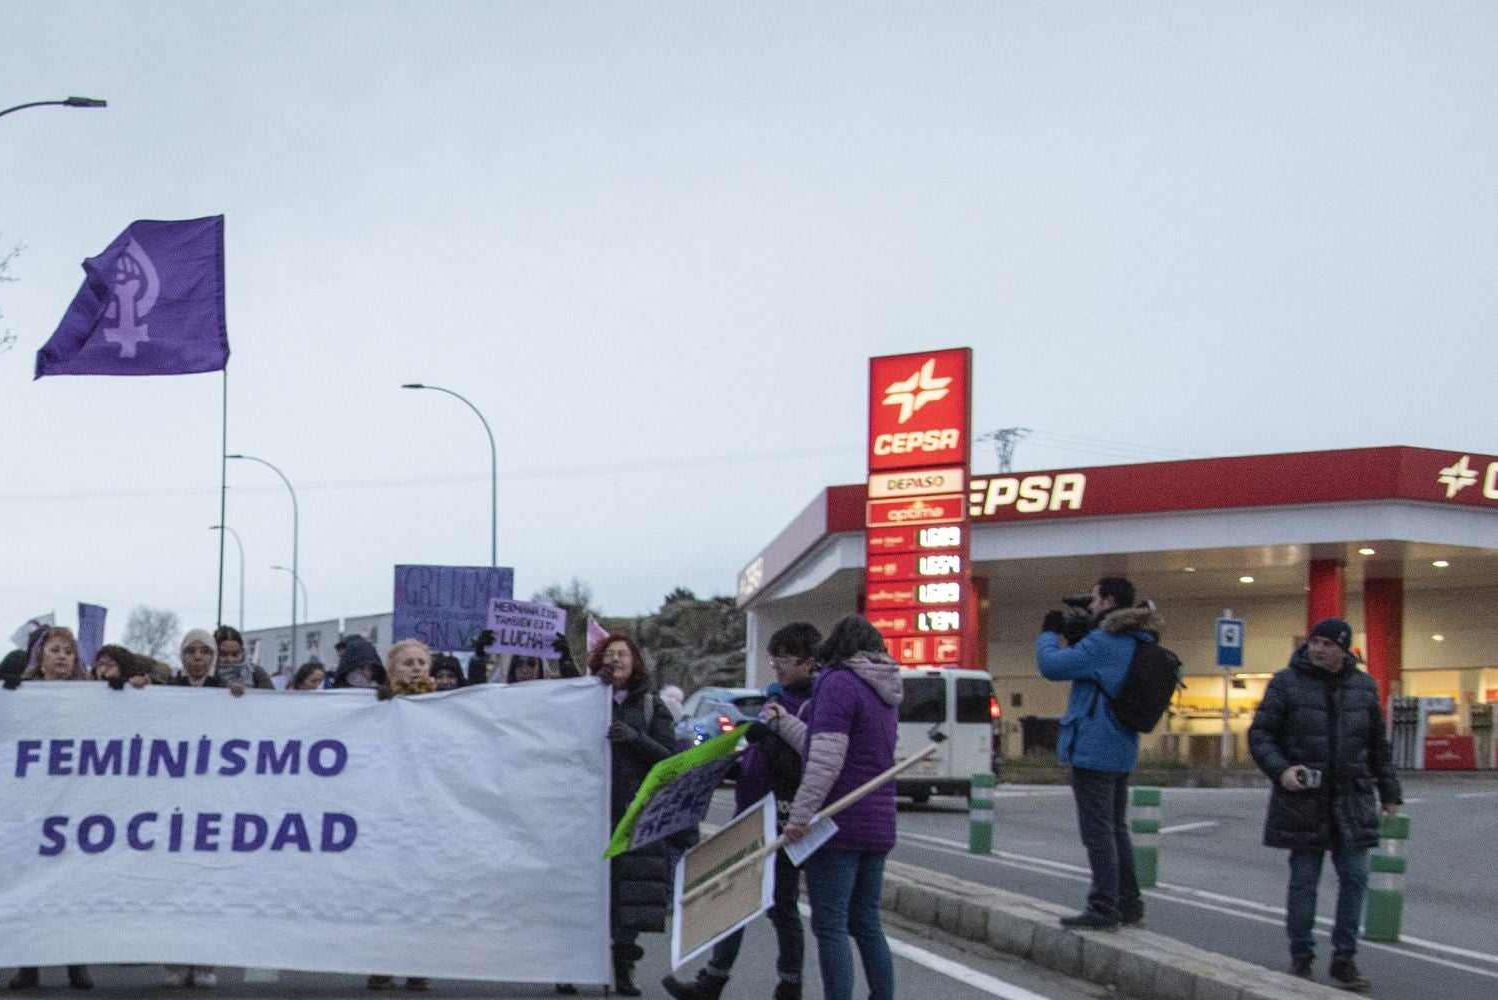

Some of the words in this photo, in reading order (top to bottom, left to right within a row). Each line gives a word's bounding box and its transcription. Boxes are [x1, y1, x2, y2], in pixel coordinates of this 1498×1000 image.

[874, 428, 960, 456] CEPSA
[969, 473, 1087, 516] EPSA
[38, 808, 359, 856] SOCIEDAD
